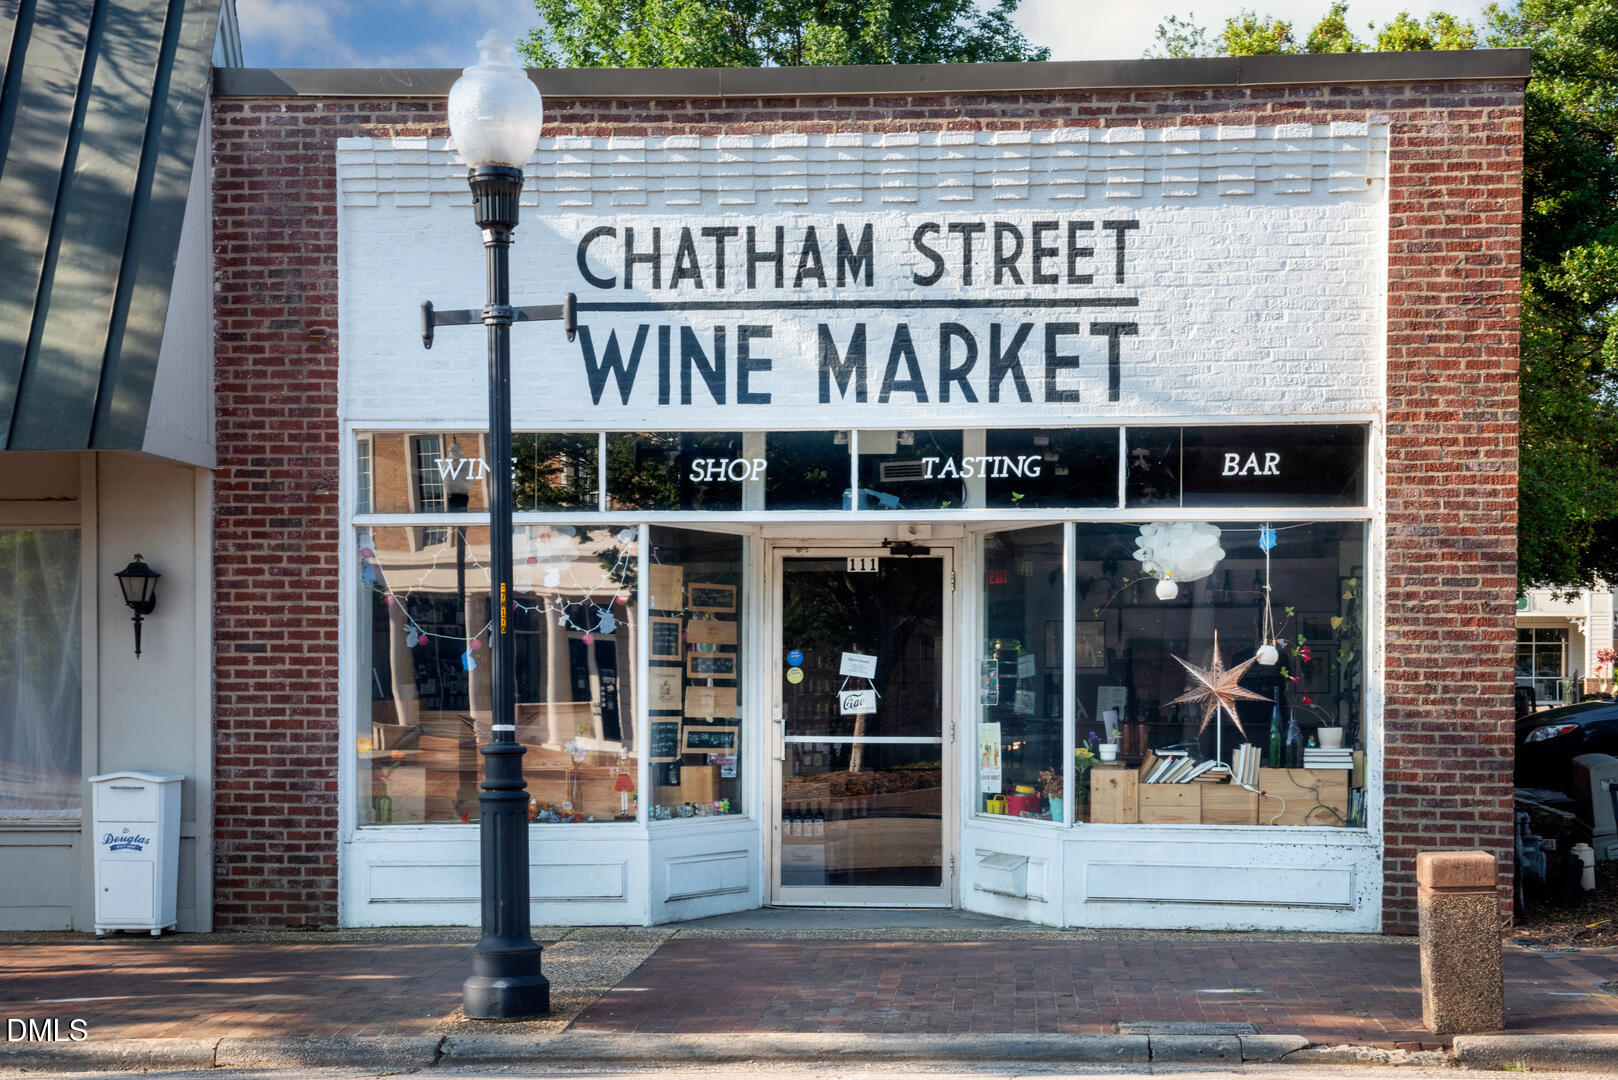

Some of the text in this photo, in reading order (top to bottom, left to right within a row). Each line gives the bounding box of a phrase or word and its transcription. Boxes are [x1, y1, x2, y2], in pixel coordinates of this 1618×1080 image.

[576, 220, 1140, 290] CHATHAM STREET
[577, 321, 1139, 406] WINE MARKET
[689, 458, 768, 482] SHOP
[921, 455, 1042, 479] TASTING
[1222, 452, 1281, 476] BAR
[848, 558, 878, 572] 111
[102, 832, 151, 846] Douglas
